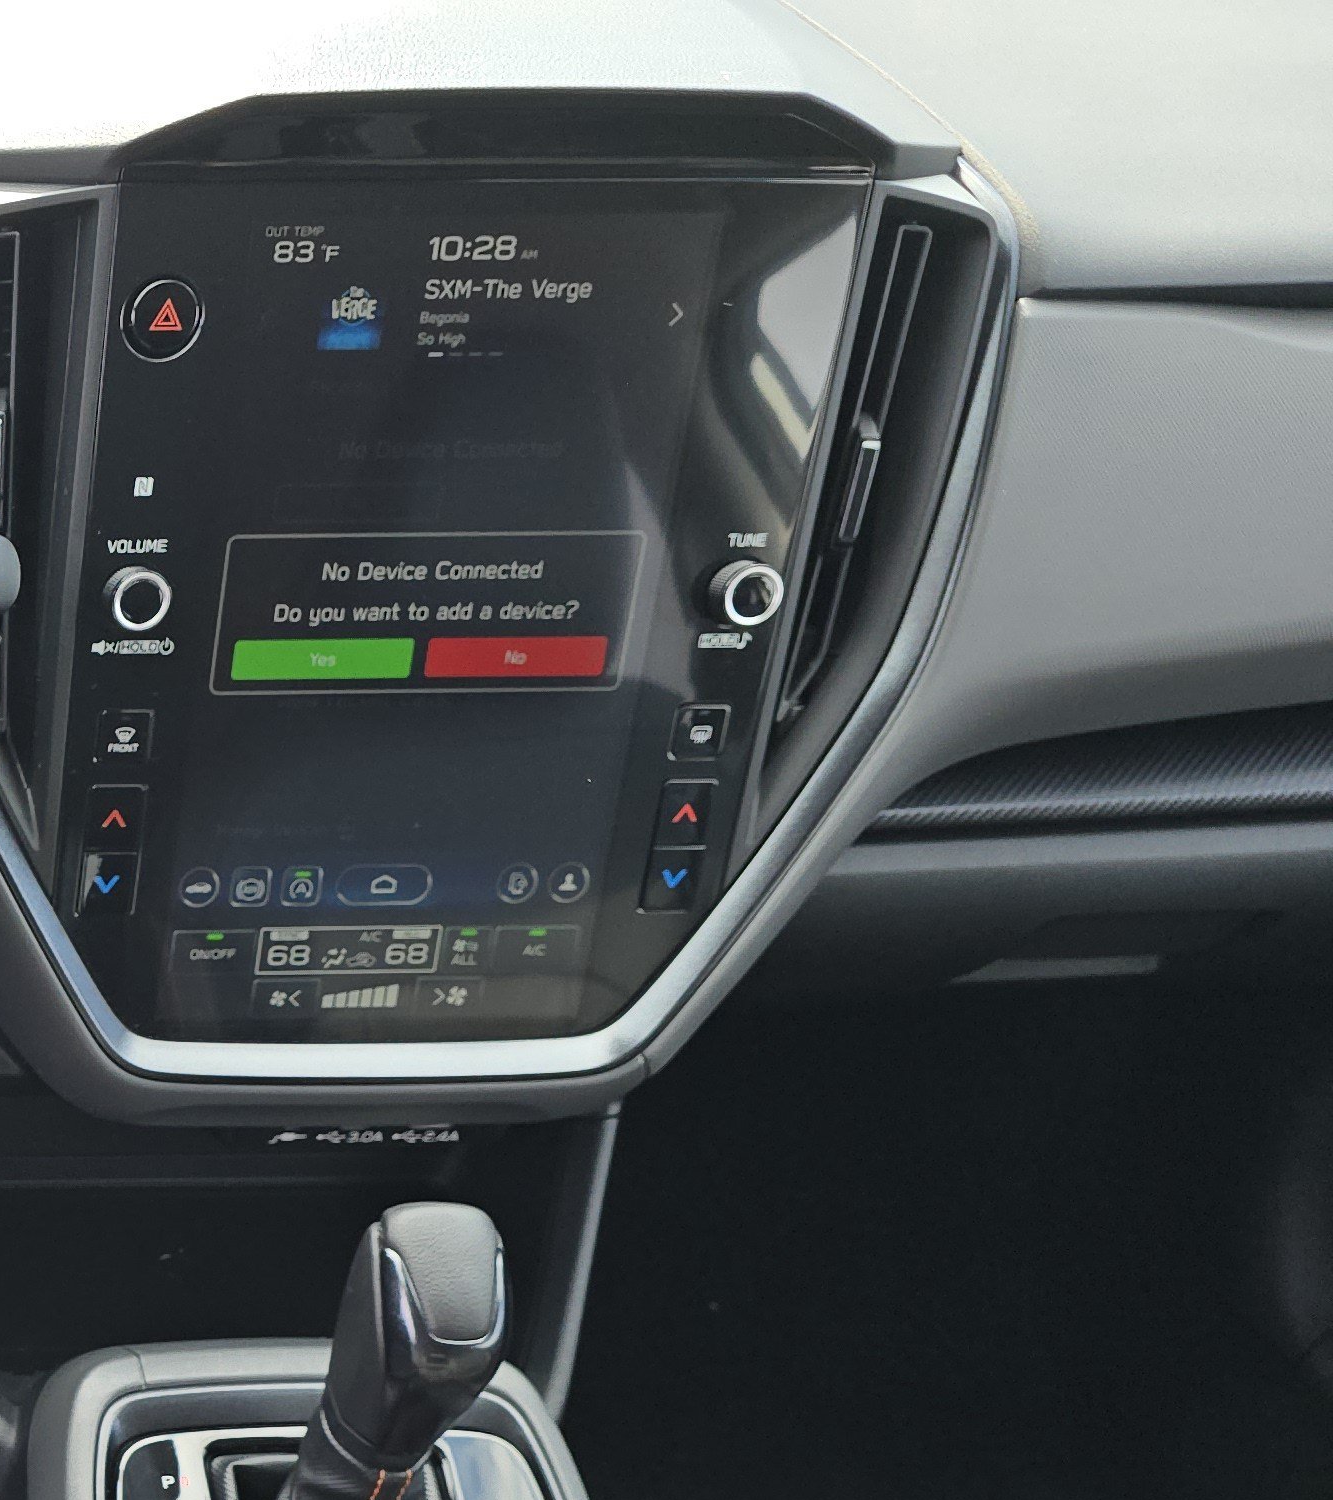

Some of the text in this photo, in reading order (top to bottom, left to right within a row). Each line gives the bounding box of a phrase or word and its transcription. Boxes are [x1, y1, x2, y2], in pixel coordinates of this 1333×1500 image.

[265, 225, 325, 238] OUT TEMP
[273, 240, 315, 264] 83
[429, 235, 519, 262] 10:28
[424, 278, 593, 304] SXM-The Verge
[419, 311, 470, 327] Begonia
[417, 332, 466, 348] So High
[107, 538, 169, 554] VOLUME
[728, 533, 769, 548] TUNE
[321, 559, 545, 582] No Device Connected
[273, 599, 581, 627] Do you want to add a device?
[309, 652, 337, 667] Yes
[504, 650, 527, 665] No
[189, 947, 237, 961] ON/OFF
[266, 944, 311, 967] 68
[384, 943, 429, 966] 68
[522, 943, 548, 957] A/C
[450, 953, 478, 966] ALL
[160, 1475, 176, 1490] P
